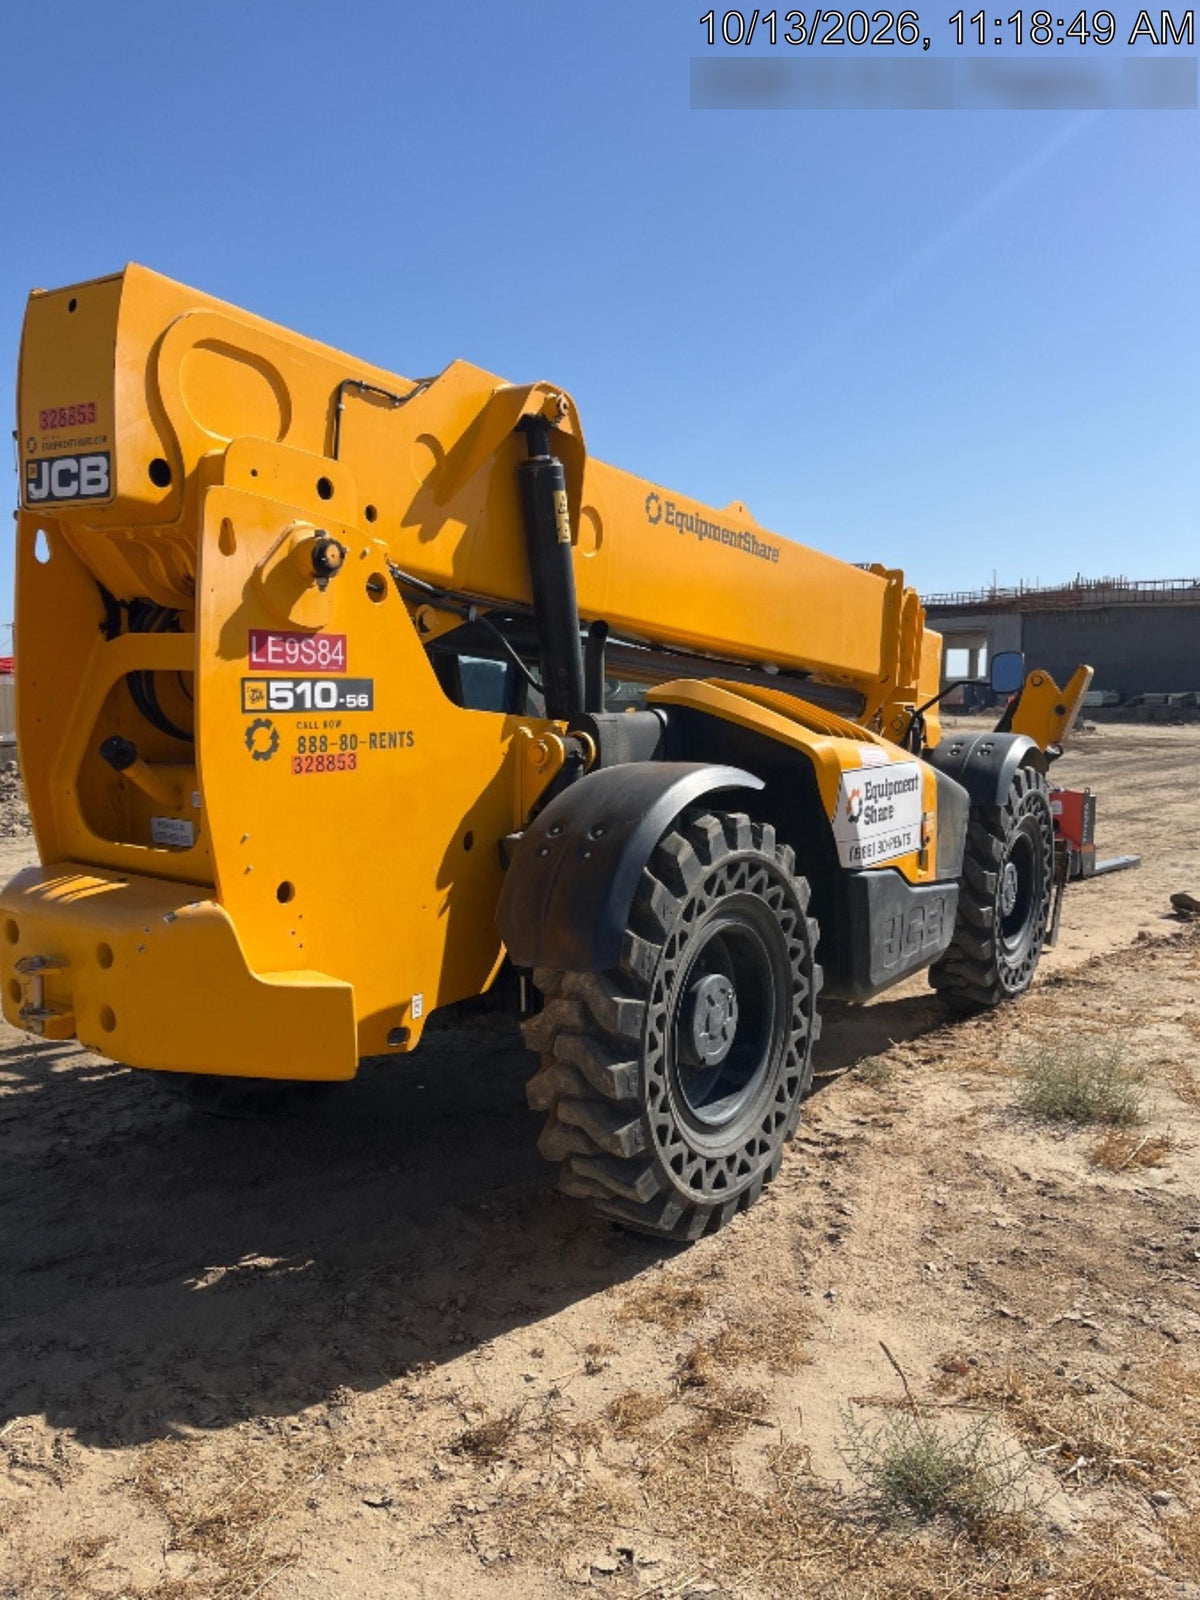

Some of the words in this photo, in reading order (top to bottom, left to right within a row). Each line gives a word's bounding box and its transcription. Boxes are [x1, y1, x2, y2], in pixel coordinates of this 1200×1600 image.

[40, 402, 96, 430] 328853
[27, 455, 109, 499] JCB
[664, 500, 780, 563] EquipmentShare
[251, 635, 344, 666] LE9S84
[268, 680, 369, 710] 510-56
[296, 721, 319, 730] CALL
[323, 720, 342, 729] NOW
[297, 731, 415, 755] 888-80-RENTS
[294, 753, 357, 774] 328853
[864, 774, 919, 804] Equipment
[864, 804, 895, 825] Share
